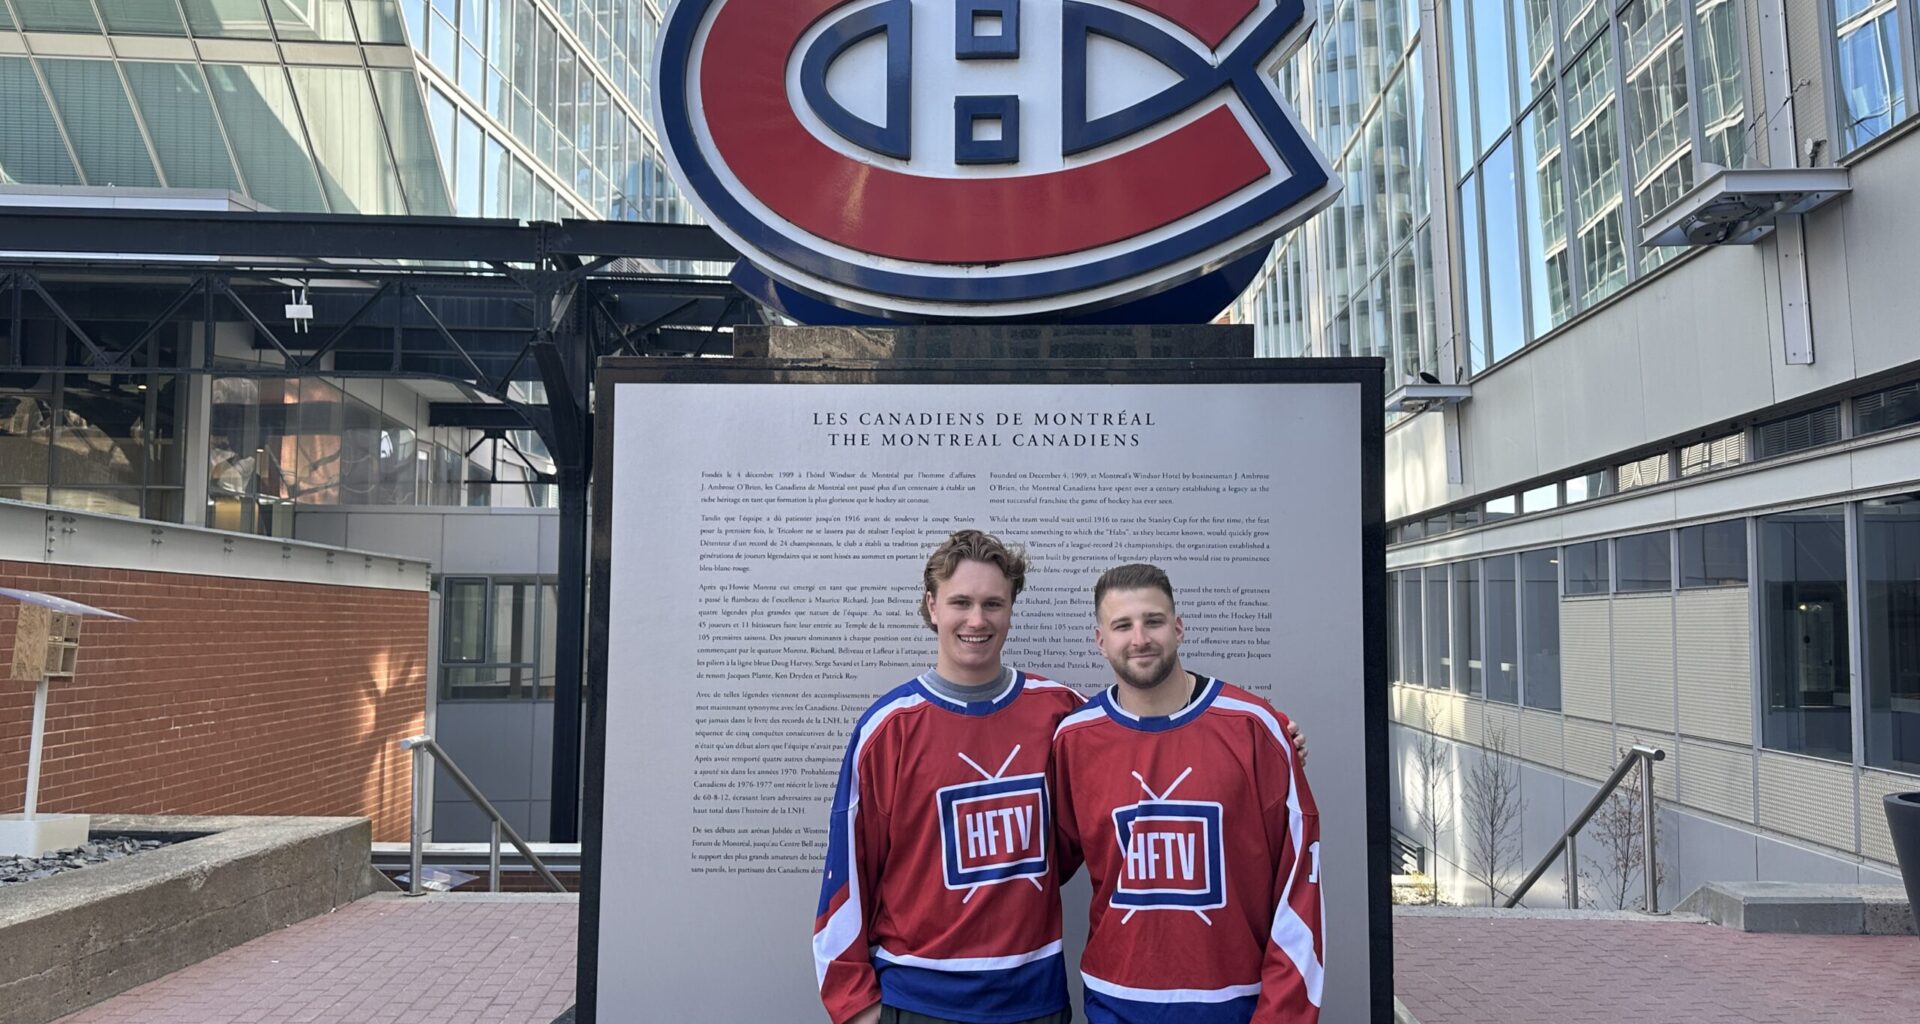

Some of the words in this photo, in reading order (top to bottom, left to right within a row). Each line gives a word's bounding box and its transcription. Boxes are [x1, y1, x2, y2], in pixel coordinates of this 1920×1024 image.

[813, 412, 848, 426] LES
[859, 412, 985, 426] CANADIENS
[996, 412, 1023, 426] DE
[1034, 409, 1156, 426] MONTRÉAL
[828, 433, 870, 447] THE
[882, 433, 1001, 447] MONTREAL
[1012, 433, 1139, 447] CANADIENS
[828, 471, 856, 479] Windsor
[989, 471, 1018, 479] Founded
[1028, 471, 1061, 479] December
[1132, 471, 1160, 479] Windsor
[1161, 471, 1181, 479] Hotel
[1018, 484, 1030, 492] the
[1030, 484, 1061, 492] Montreal
[1062, 484, 1096, 492] Canadiens
[1097, 484, 1113, 492] have
[1114, 485, 1132, 494] spent
[1154, 485, 1180, 494] century
[1181, 484, 1221, 494] establishing
[1227, 484, 1248, 494] legacy
[1258, 484, 1269, 492] the
[1107, 497, 1130, 506] hockey
[1131, 497, 1142, 505] has
[989, 515, 1009, 523] While
[1009, 515, 1020, 523] the
[1038, 515, 1060, 523] would
[1147, 516, 1172, 525] Stanley
[1172, 516, 1188, 525] Cup
[1188, 516, 1198, 524] for
[1199, 516, 1210, 524] the
[1211, 516, 1225, 524] first
[1245, 516, 1256, 524] the
[1257, 516, 1270, 524] feat
[1005, 528, 1029, 536] became
[1029, 528, 1064, 538] something
[1072, 528, 1093, 536] which
[1093, 528, 1104, 536] the
[1140, 528, 1155, 538] they
[1155, 528, 1180, 536] became
[1227, 529, 1252, 538] quickly
[1029, 540, 1056, 548] Winners
[1175, 541, 1186, 549] the
[1045, 553, 1061, 561] built
[1071, 554, 1108, 563] generations
[1117, 554, 1148, 563] legendary
[1149, 554, 1172, 563] players
[1173, 554, 1188, 562] who
[1188, 554, 1209, 562] would
[1231, 555, 1270, 564] prominence
[1179, 586, 1201, 595] passed
[1201, 586, 1213, 594] the
[1213, 586, 1231, 594] torch
[1240, 587, 1270, 596] greatness
[1196, 599, 1216, 608] giants
[1226, 599, 1237, 607] the
[1186, 650, 1226, 660] goaltending
[1226, 651, 1246, 660] greats
[1246, 650, 1272, 660] Jacques
[1012, 661, 1026, 669] Ken
[1027, 661, 1052, 671] Dryden
[1053, 661, 1066, 669] and
[1066, 661, 1090, 669] Patrick
[726, 672, 750, 681] Jacques
[774, 672, 788, 680] Ken
[788, 672, 813, 681] Dryden
[821, 672, 844, 680] Patrick
[693, 780, 727, 788] Canadiens
[814, 781, 828, 789] livre
[692, 806, 708, 814] haut
[708, 806, 724, 814] total
[724, 806, 740, 814] dans
[965, 805, 1033, 859] HFTV
[1127, 832, 1196, 881] HFTV
